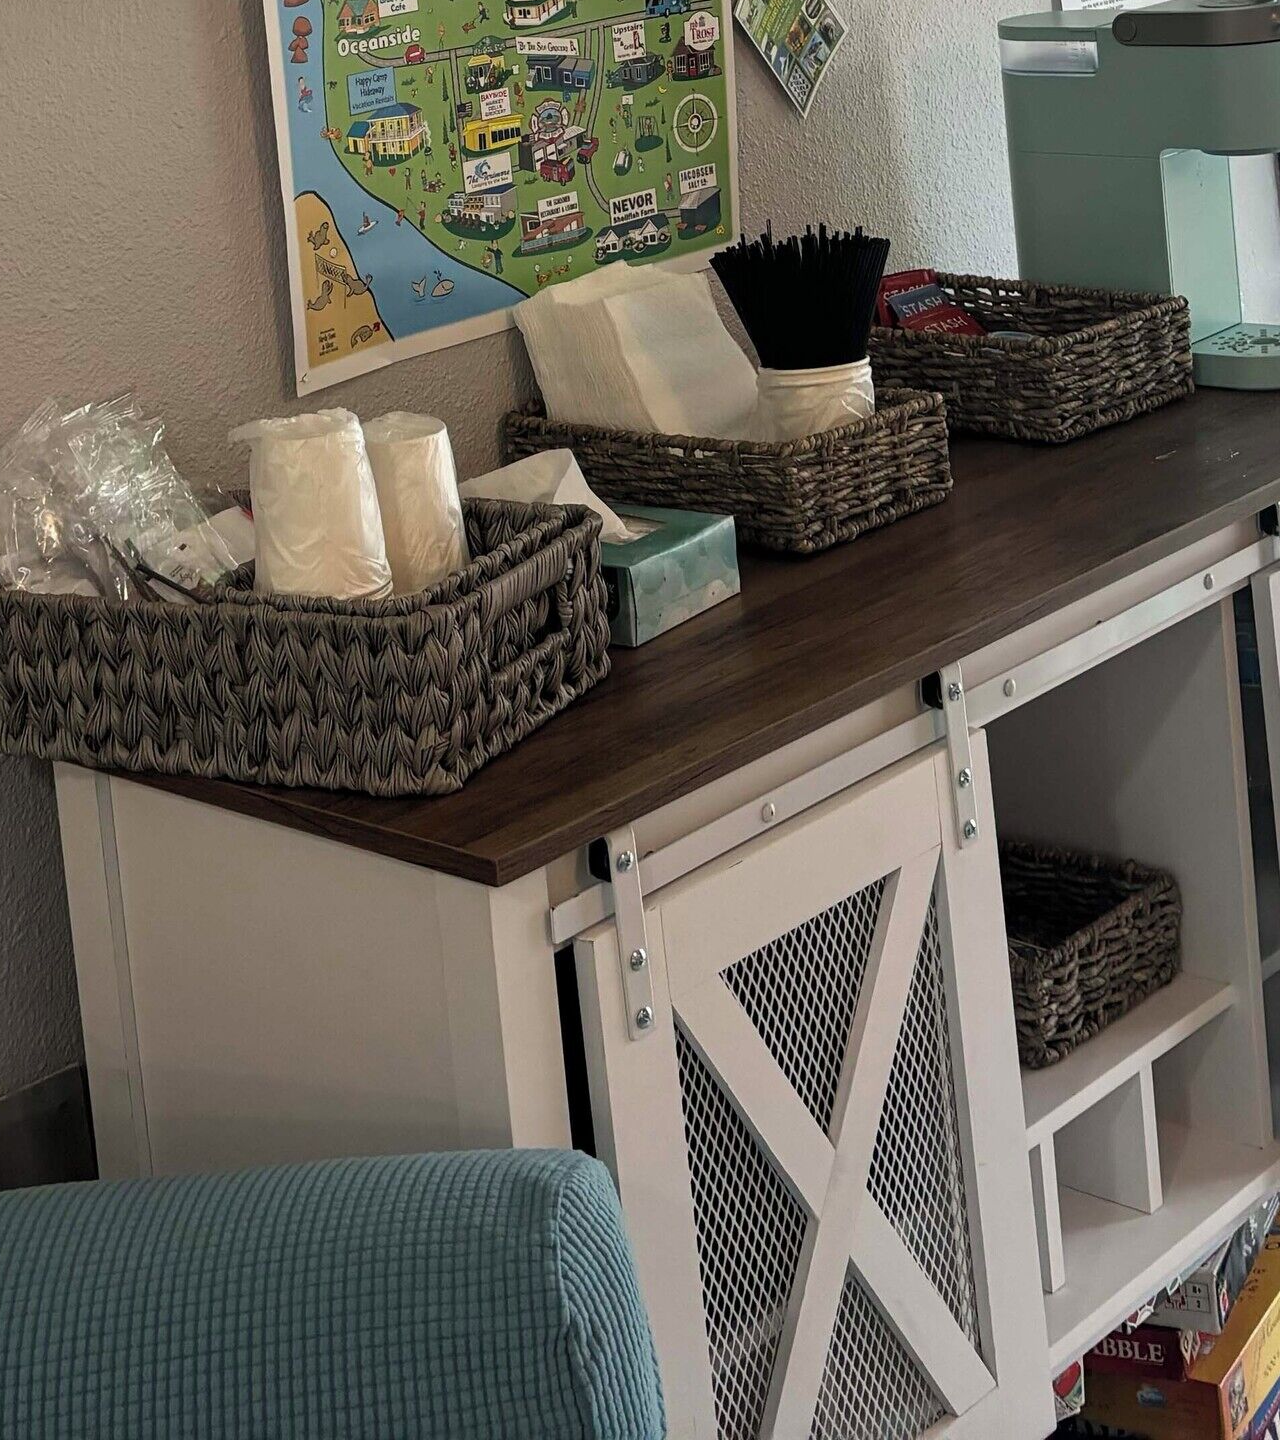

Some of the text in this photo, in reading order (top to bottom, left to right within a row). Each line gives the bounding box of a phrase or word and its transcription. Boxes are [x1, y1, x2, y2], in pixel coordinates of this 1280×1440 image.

[613, 23, 643, 34] Upstairs
[337, 24, 421, 57] Oceanside
[481, 89, 507, 101] BAYSIDE
[680, 164, 715, 181] JACOBSEN
[902, 296, 943, 318] STASH
[924, 316, 968, 334] STASH
